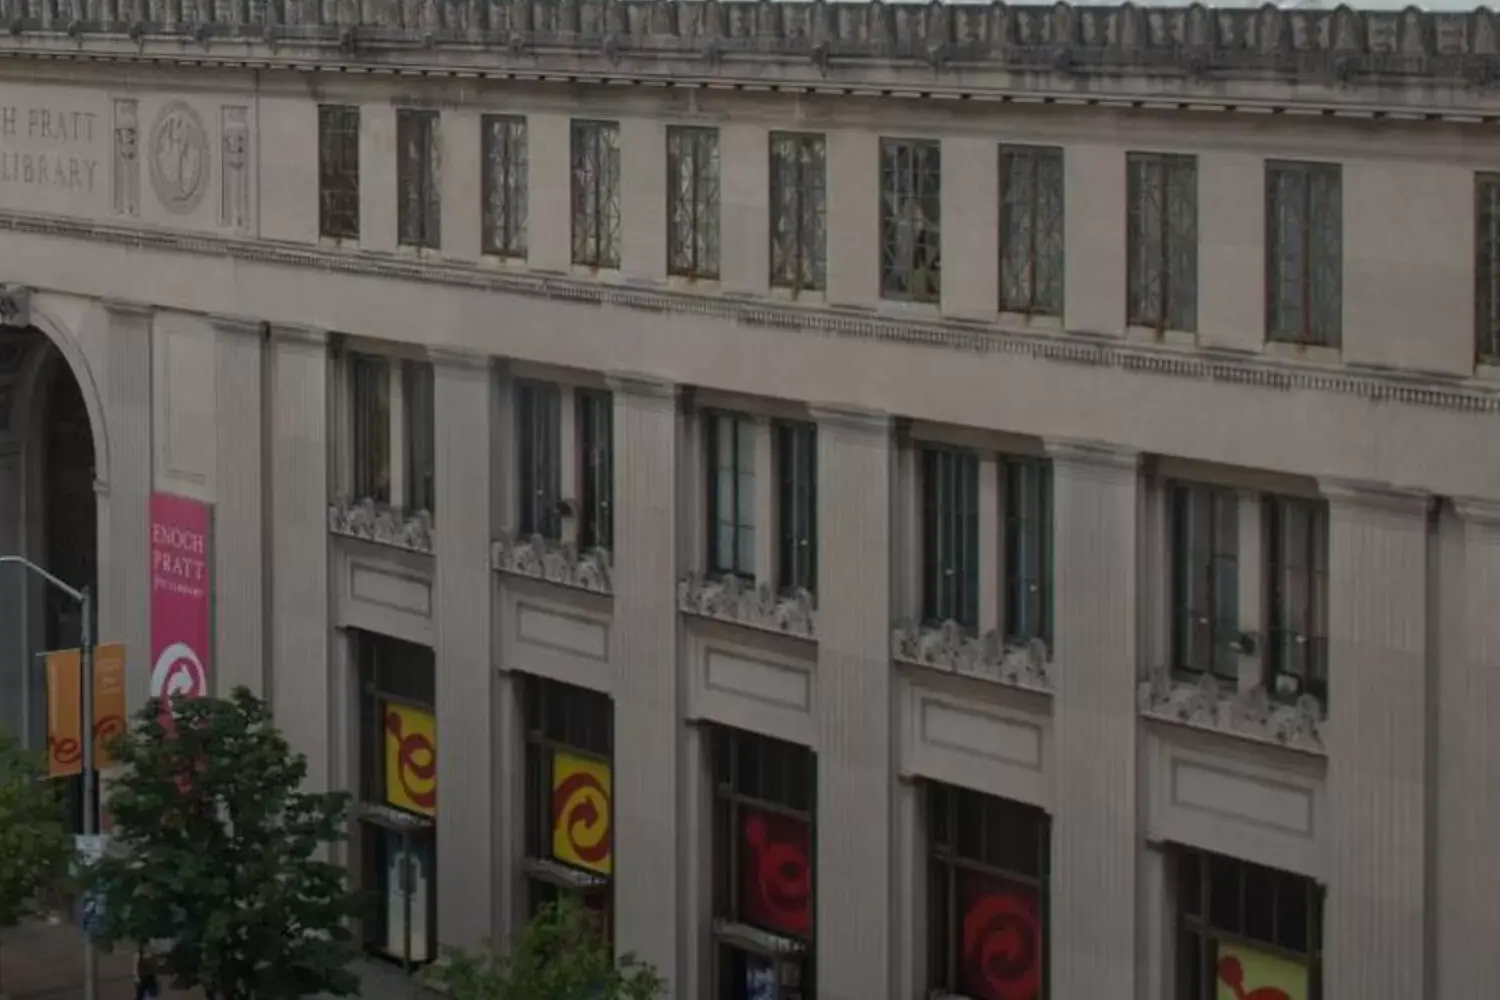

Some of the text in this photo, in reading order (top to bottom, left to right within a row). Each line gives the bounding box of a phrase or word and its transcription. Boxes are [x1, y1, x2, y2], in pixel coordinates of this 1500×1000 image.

[27, 108, 98, 143] PRATT
[2, 151, 100, 190] LIBRARY
[152, 522, 204, 553] ENOCH
[152, 549, 205, 581] PRATT
